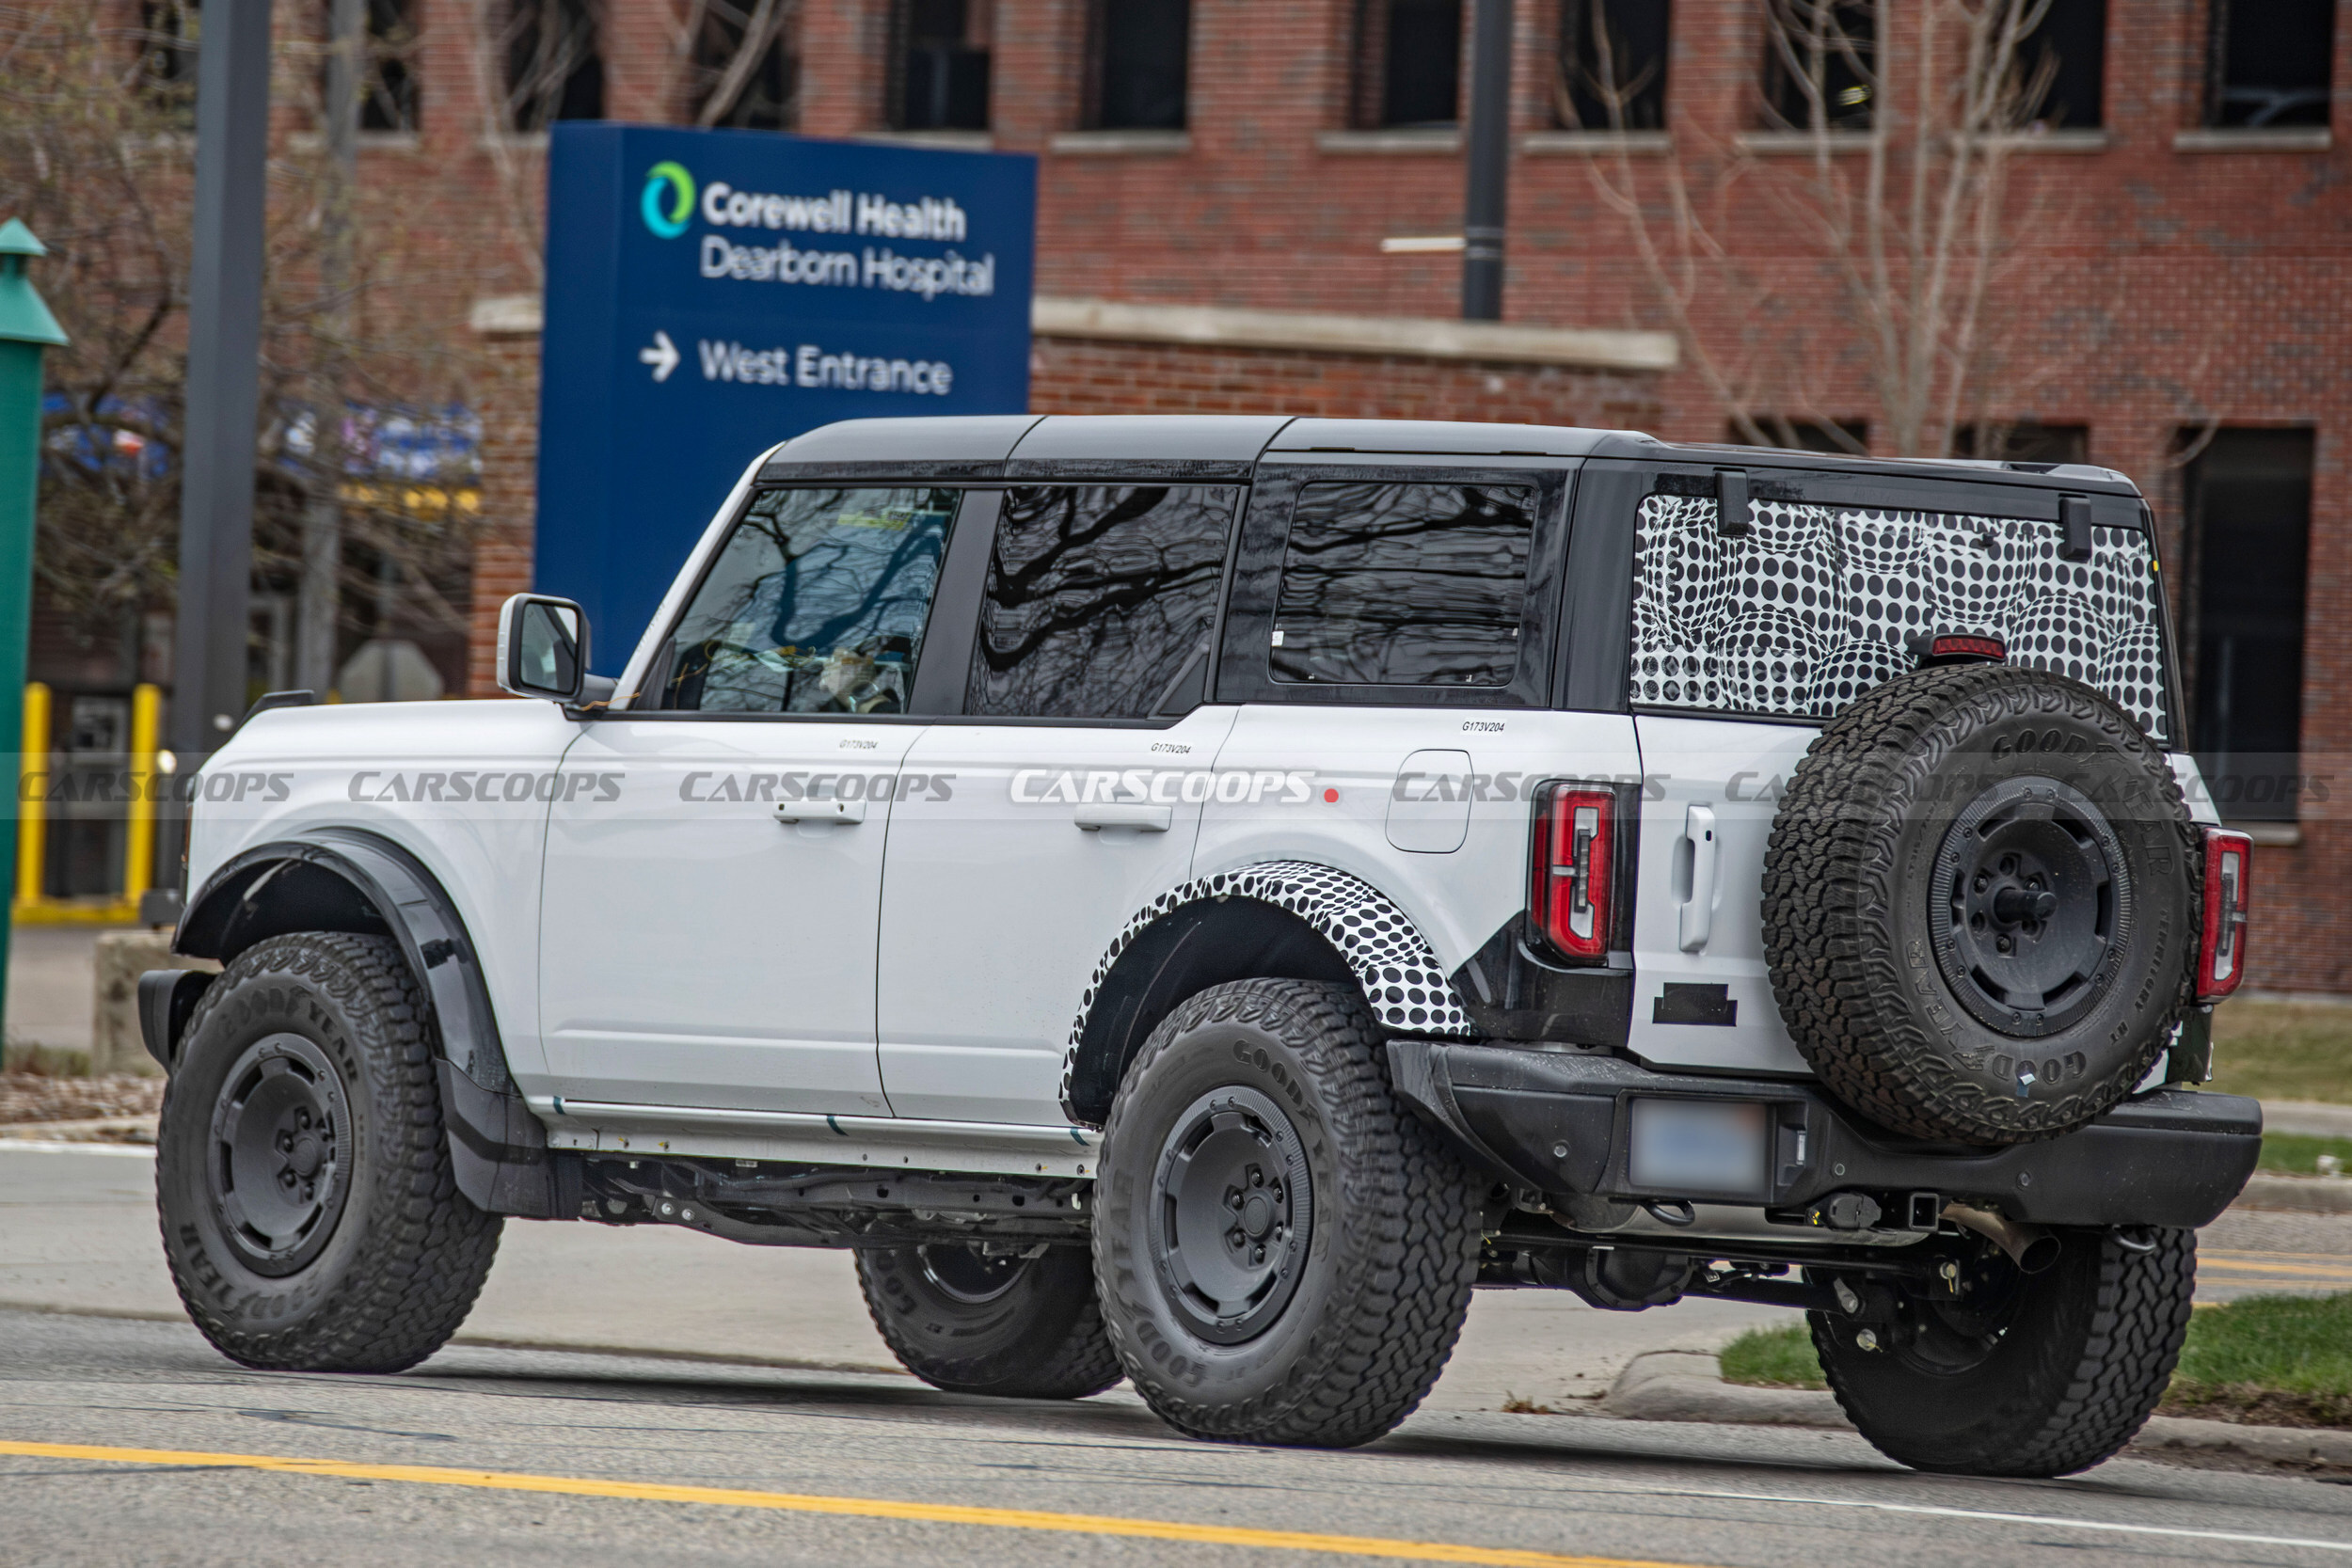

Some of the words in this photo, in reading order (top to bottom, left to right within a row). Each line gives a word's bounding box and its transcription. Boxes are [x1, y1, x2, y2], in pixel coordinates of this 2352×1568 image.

[702, 182, 851, 232] Corewell
[855, 194, 965, 241] Health
[701, 236, 856, 287] Dearborn
[862, 247, 994, 299] Hospital
[698, 340, 788, 385] West
[796, 345, 952, 395] Entrance
[1152, 742, 1192, 754] G173V204
[1462, 721, 1505, 732] G173V204
